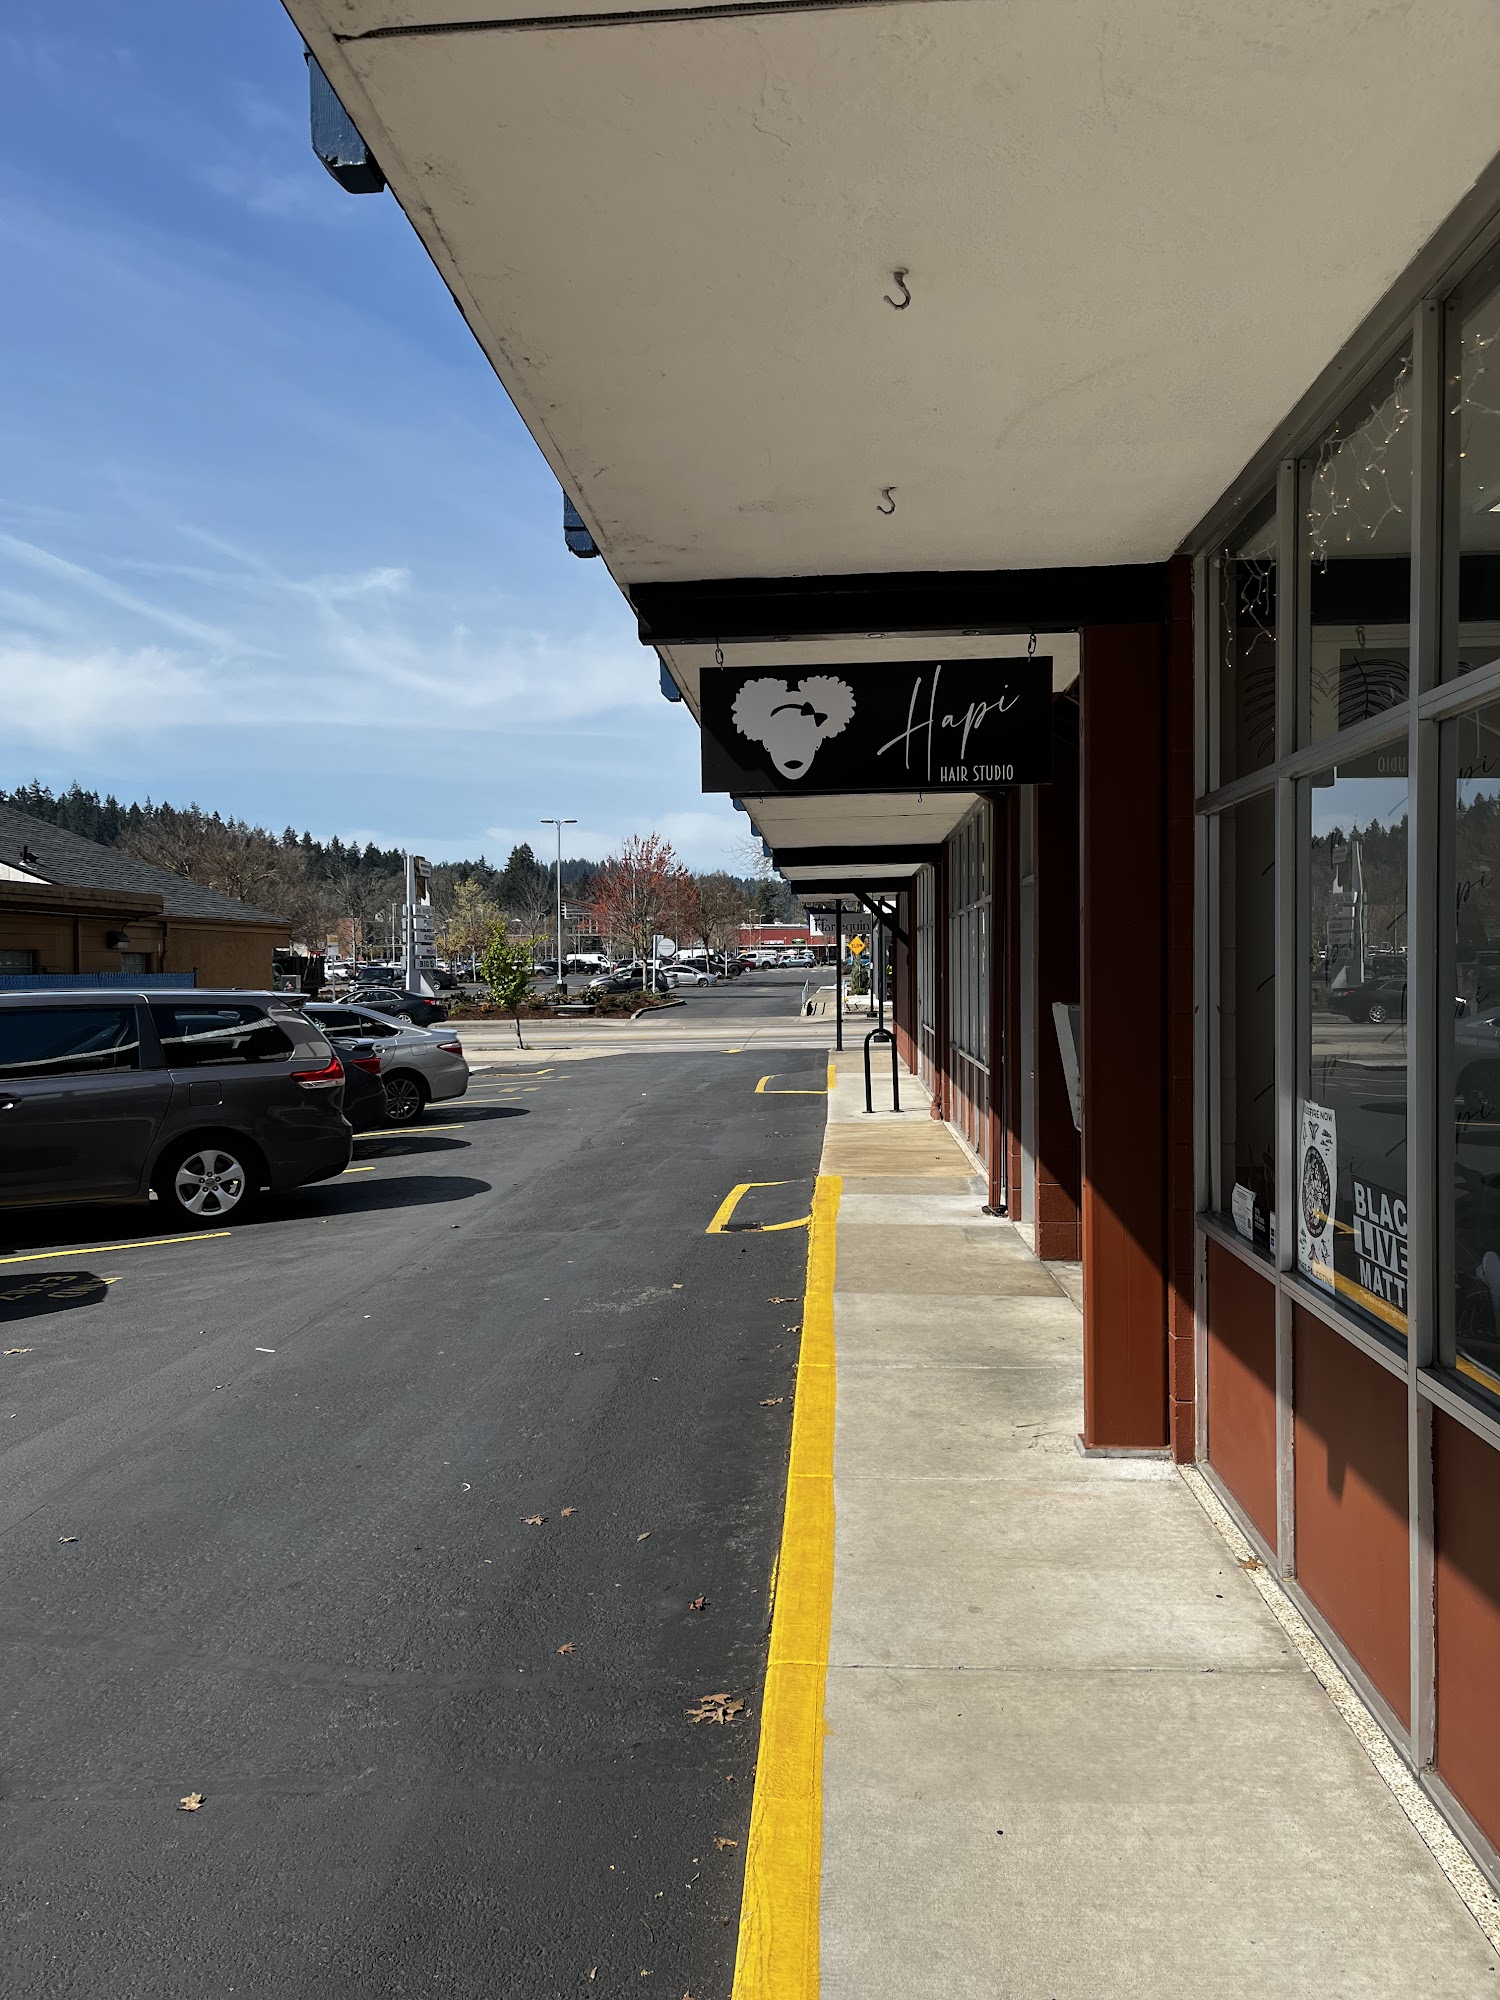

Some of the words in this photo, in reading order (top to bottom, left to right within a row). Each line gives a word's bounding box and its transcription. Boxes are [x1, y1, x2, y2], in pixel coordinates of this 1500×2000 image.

[876, 664, 1020, 782] Hapi
[939, 766, 969, 783] HAIR
[972, 764, 1015, 782] STUDIO
[815, 919, 870, 934] Harequin
[419, 960, 430, 969] BIG
[1320, 1110, 1334, 1123] NOW
[1353, 1181, 1408, 1236] BLAC
[1358, 1219, 1408, 1278] LIVE
[1358, 1257, 1408, 1310] MATT
